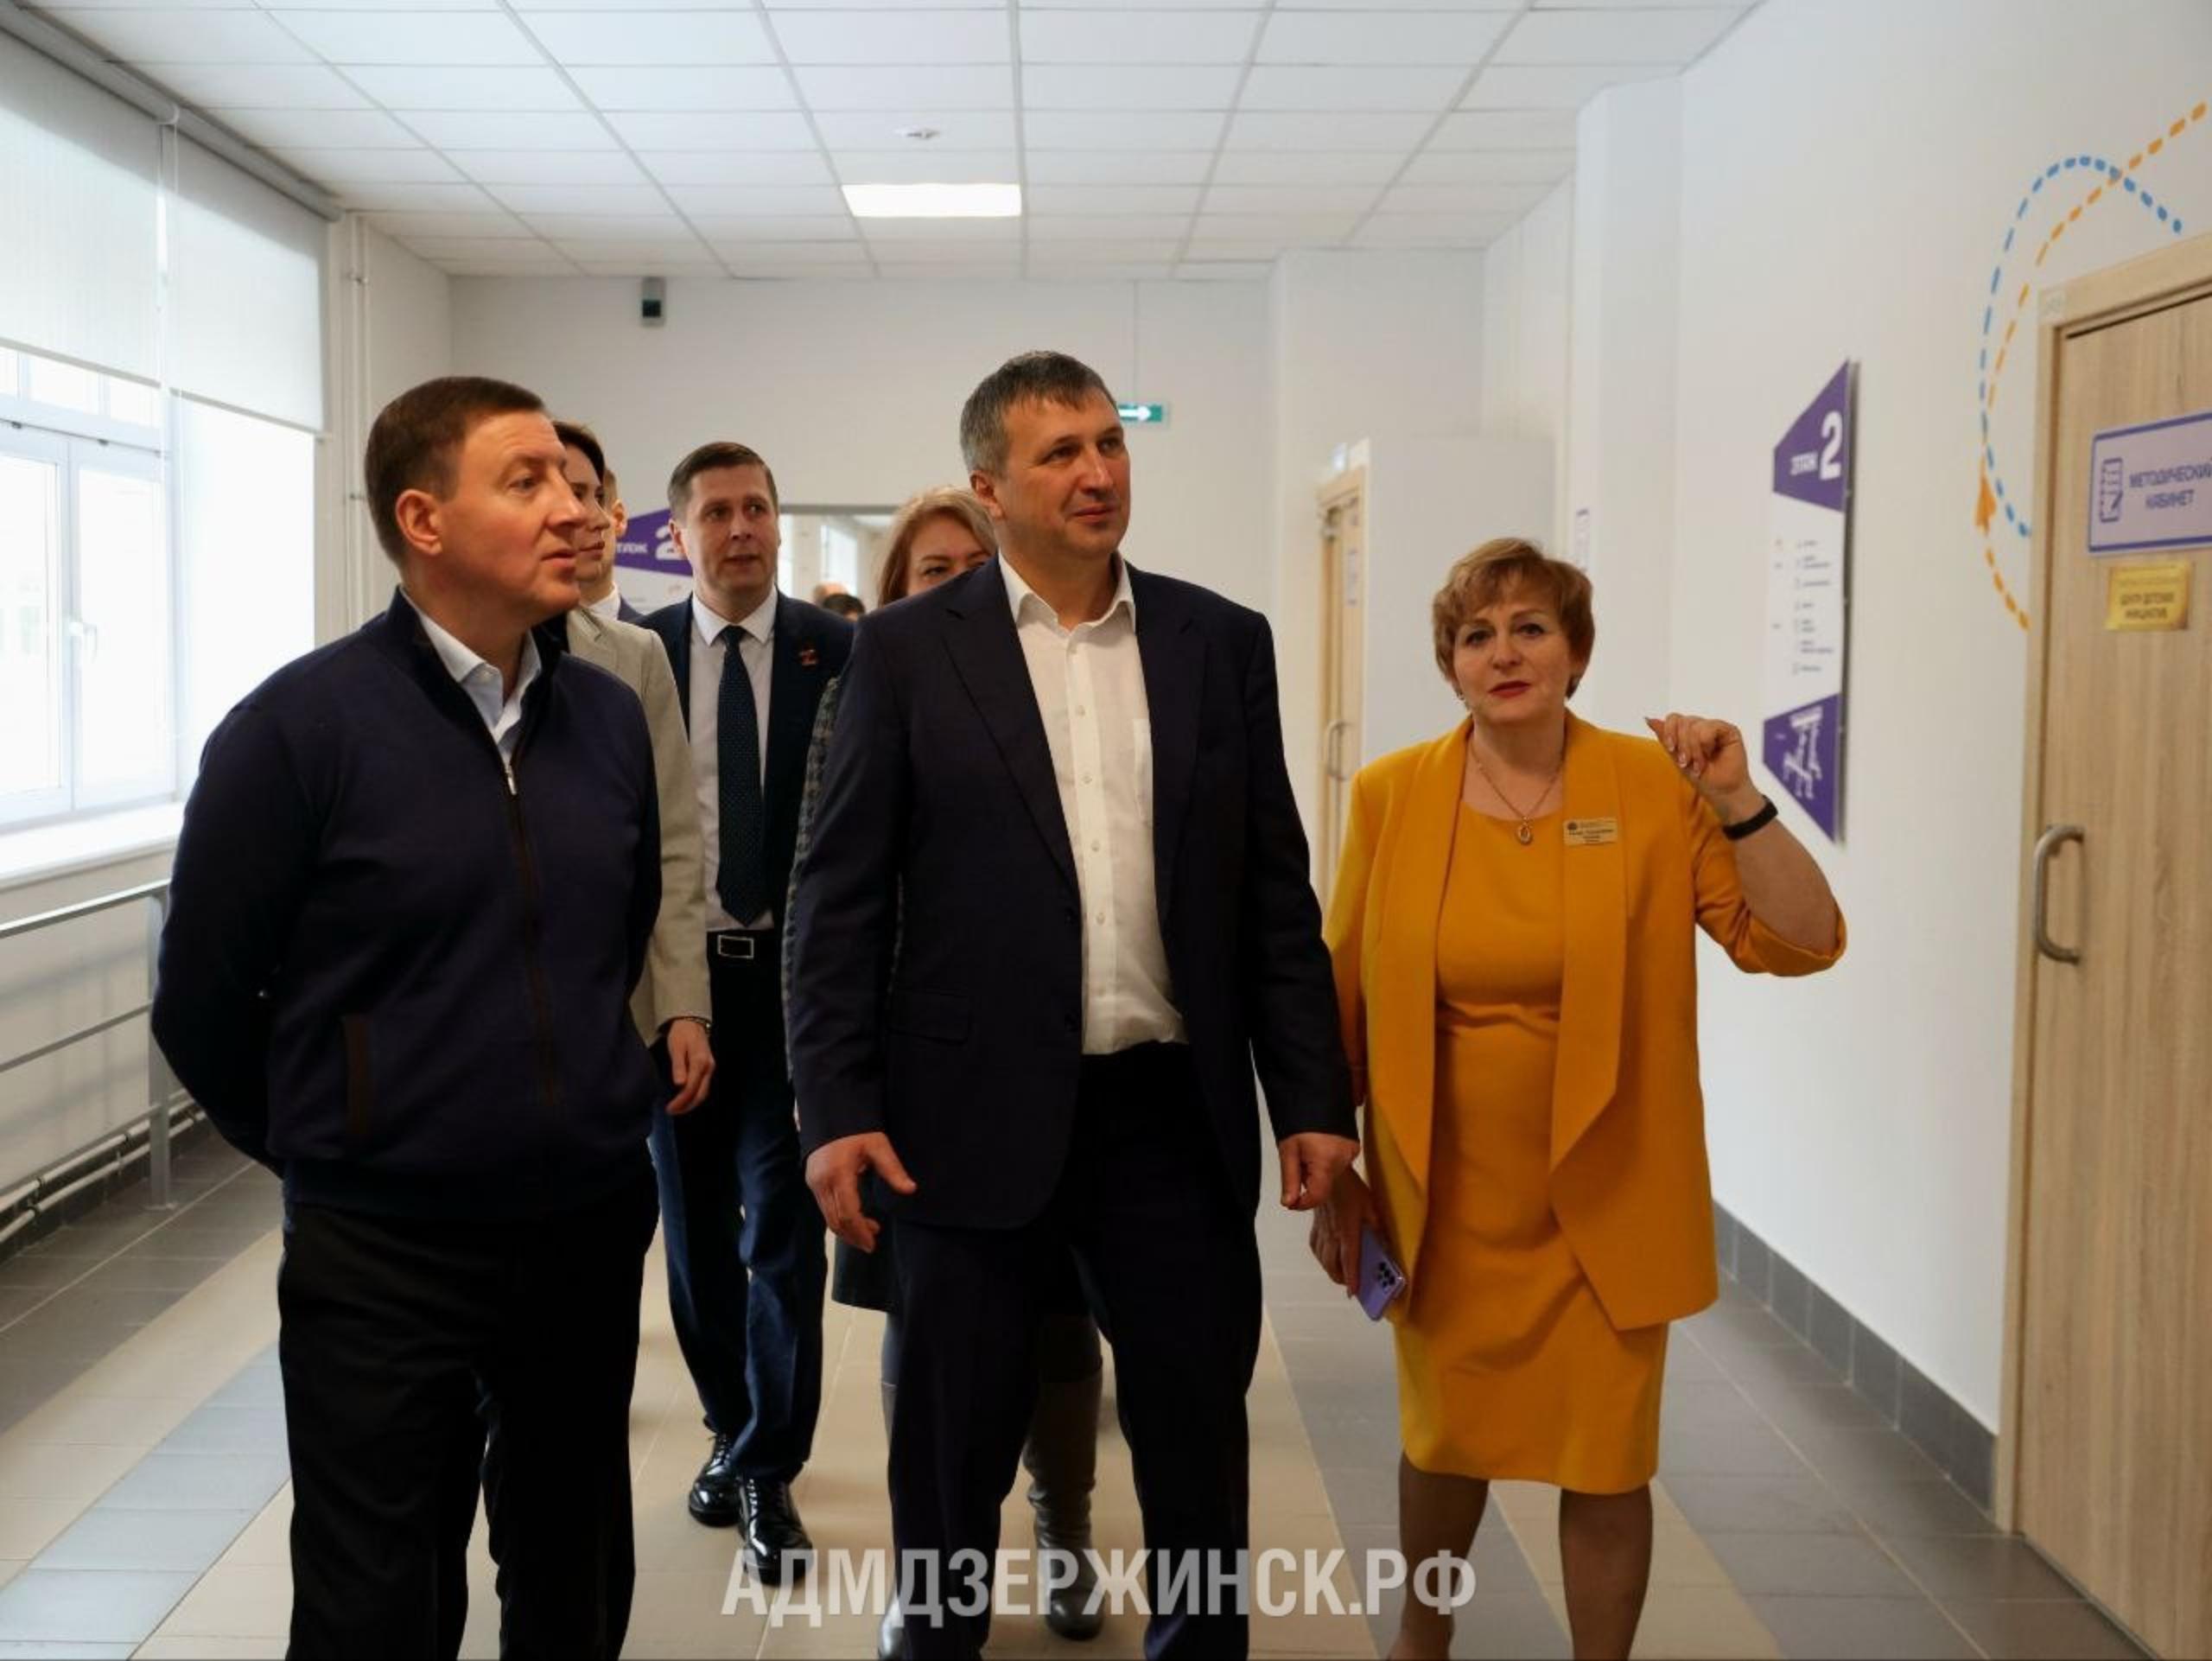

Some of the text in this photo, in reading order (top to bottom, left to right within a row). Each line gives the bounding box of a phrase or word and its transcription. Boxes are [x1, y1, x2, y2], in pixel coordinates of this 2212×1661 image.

[1820, 410, 1842, 480] 2
[2128, 462, 2212, 488] МЕТОДИЧЕСКИ
[655, 525, 686, 560] 2
